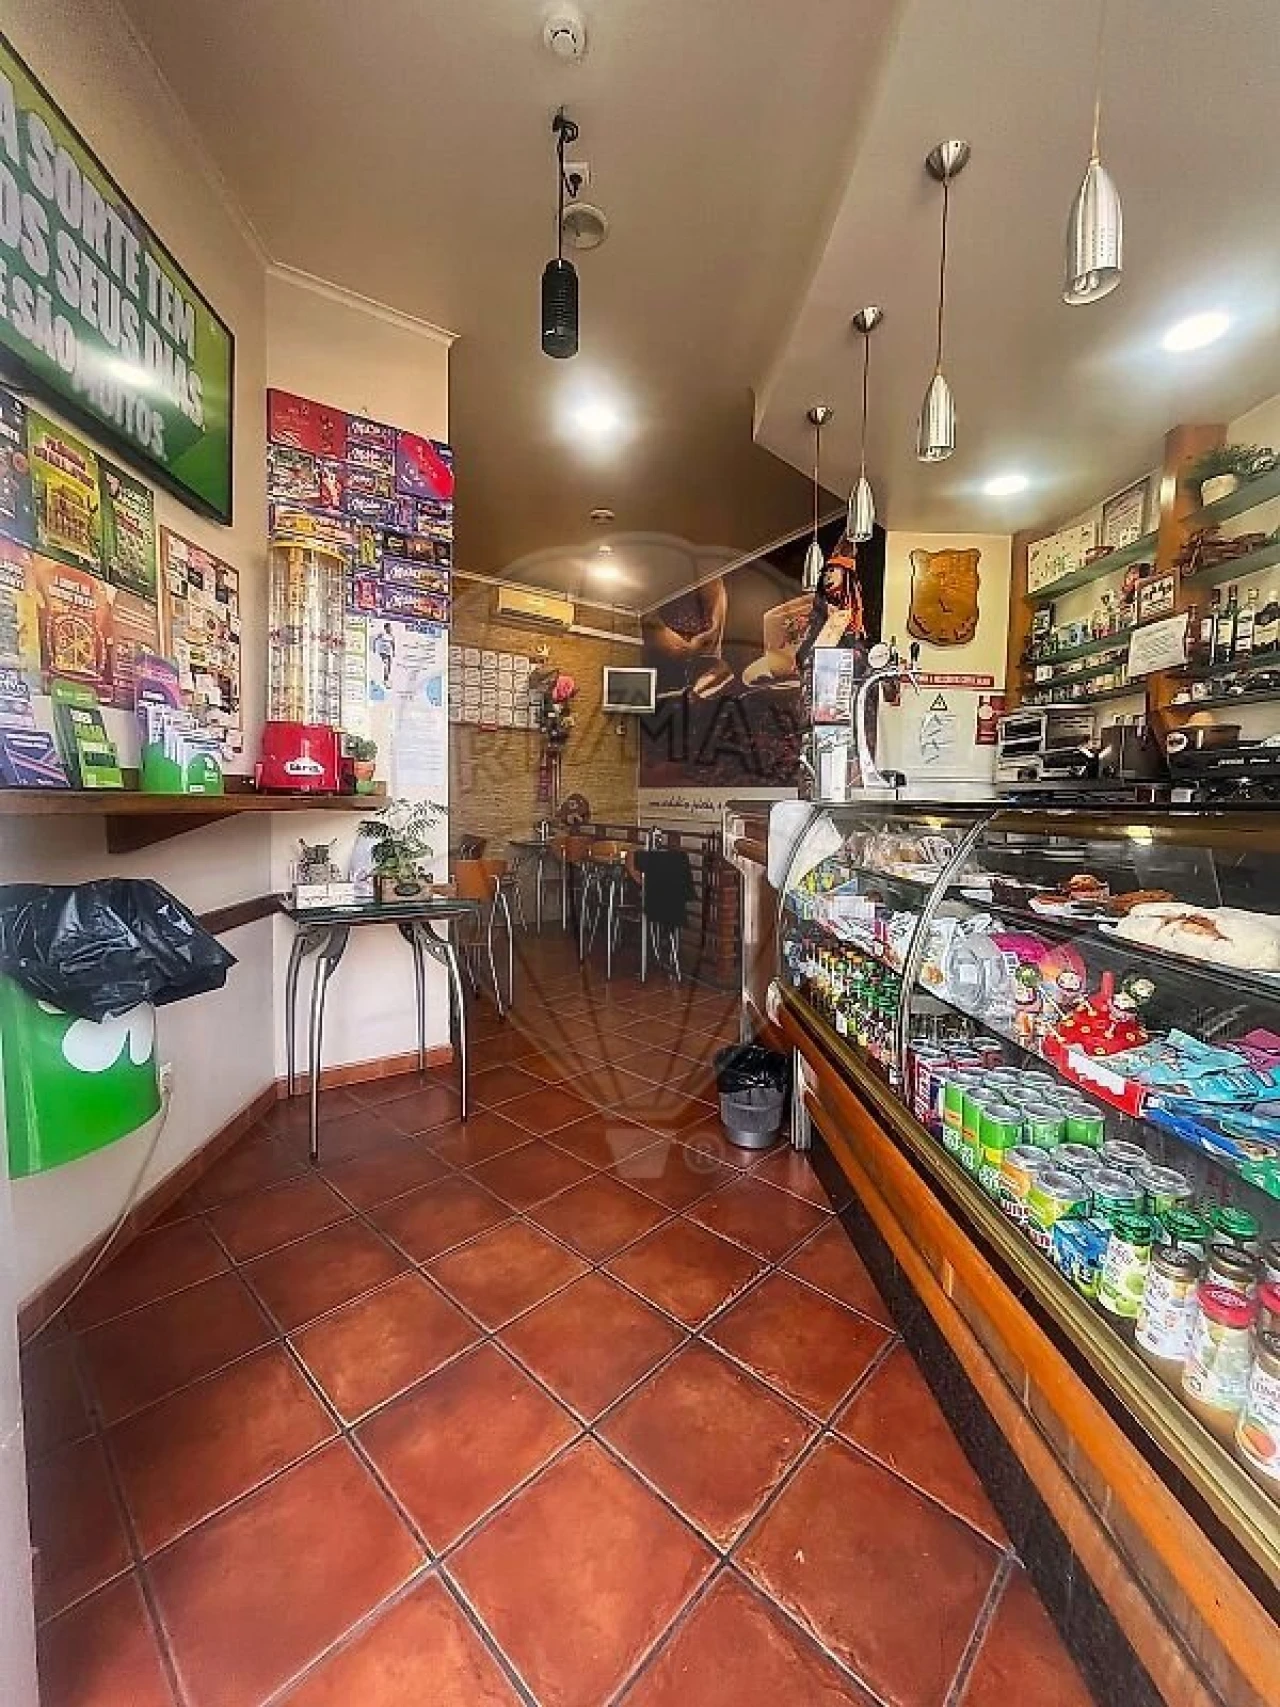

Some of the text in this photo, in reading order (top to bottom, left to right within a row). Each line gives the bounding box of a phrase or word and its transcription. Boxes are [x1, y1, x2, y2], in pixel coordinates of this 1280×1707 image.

[27, 110, 140, 299] SORTE
[145, 251, 196, 361] TEM
[55, 229, 140, 364] SEUS
[12, 272, 76, 374] SÃO
